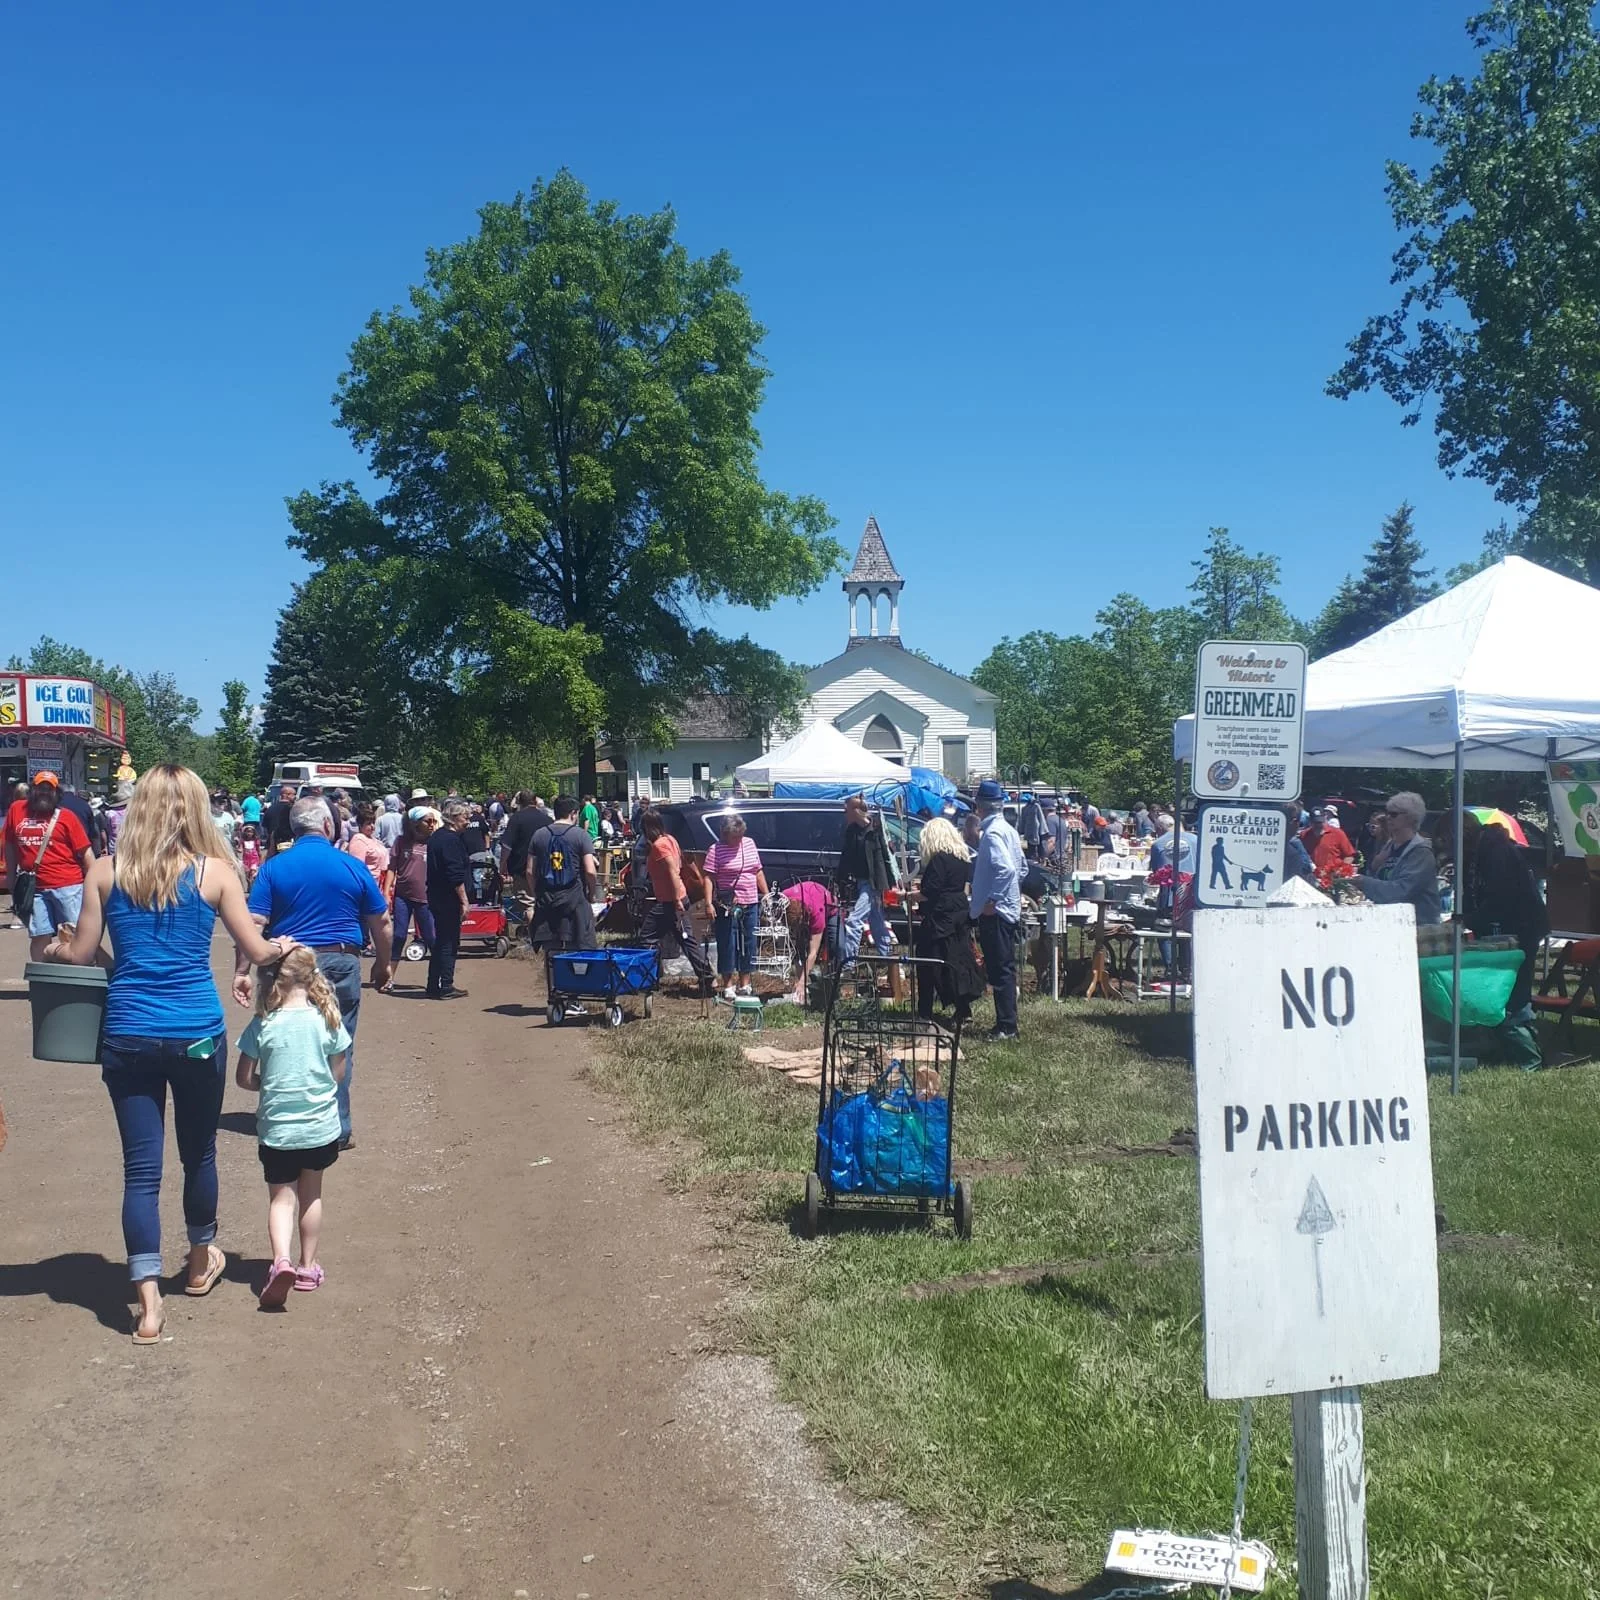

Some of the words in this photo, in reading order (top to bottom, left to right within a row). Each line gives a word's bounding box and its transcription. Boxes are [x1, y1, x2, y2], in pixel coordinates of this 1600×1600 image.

[1274, 657, 1288, 669] to
[1227, 670, 1276, 683] Historic
[35, 685, 62, 702] ICE
[1204, 690, 1296, 718] GREENMEAD
[43, 706, 91, 725] DRINKS
[1209, 814, 1246, 825] PLEASE
[1248, 815, 1280, 826] LEASH
[1209, 825, 1229, 834] AND
[1231, 826, 1263, 836] CLEAN
[1265, 827, 1279, 837] UP
[1281, 966, 1355, 1030] NO
[1224, 1096, 1411, 1152] PARKING
[1157, 1541, 1220, 1554] FOOT
[1140, 1548, 1233, 1565] TRAFFIC
[1154, 1558, 1218, 1572] ONLY
